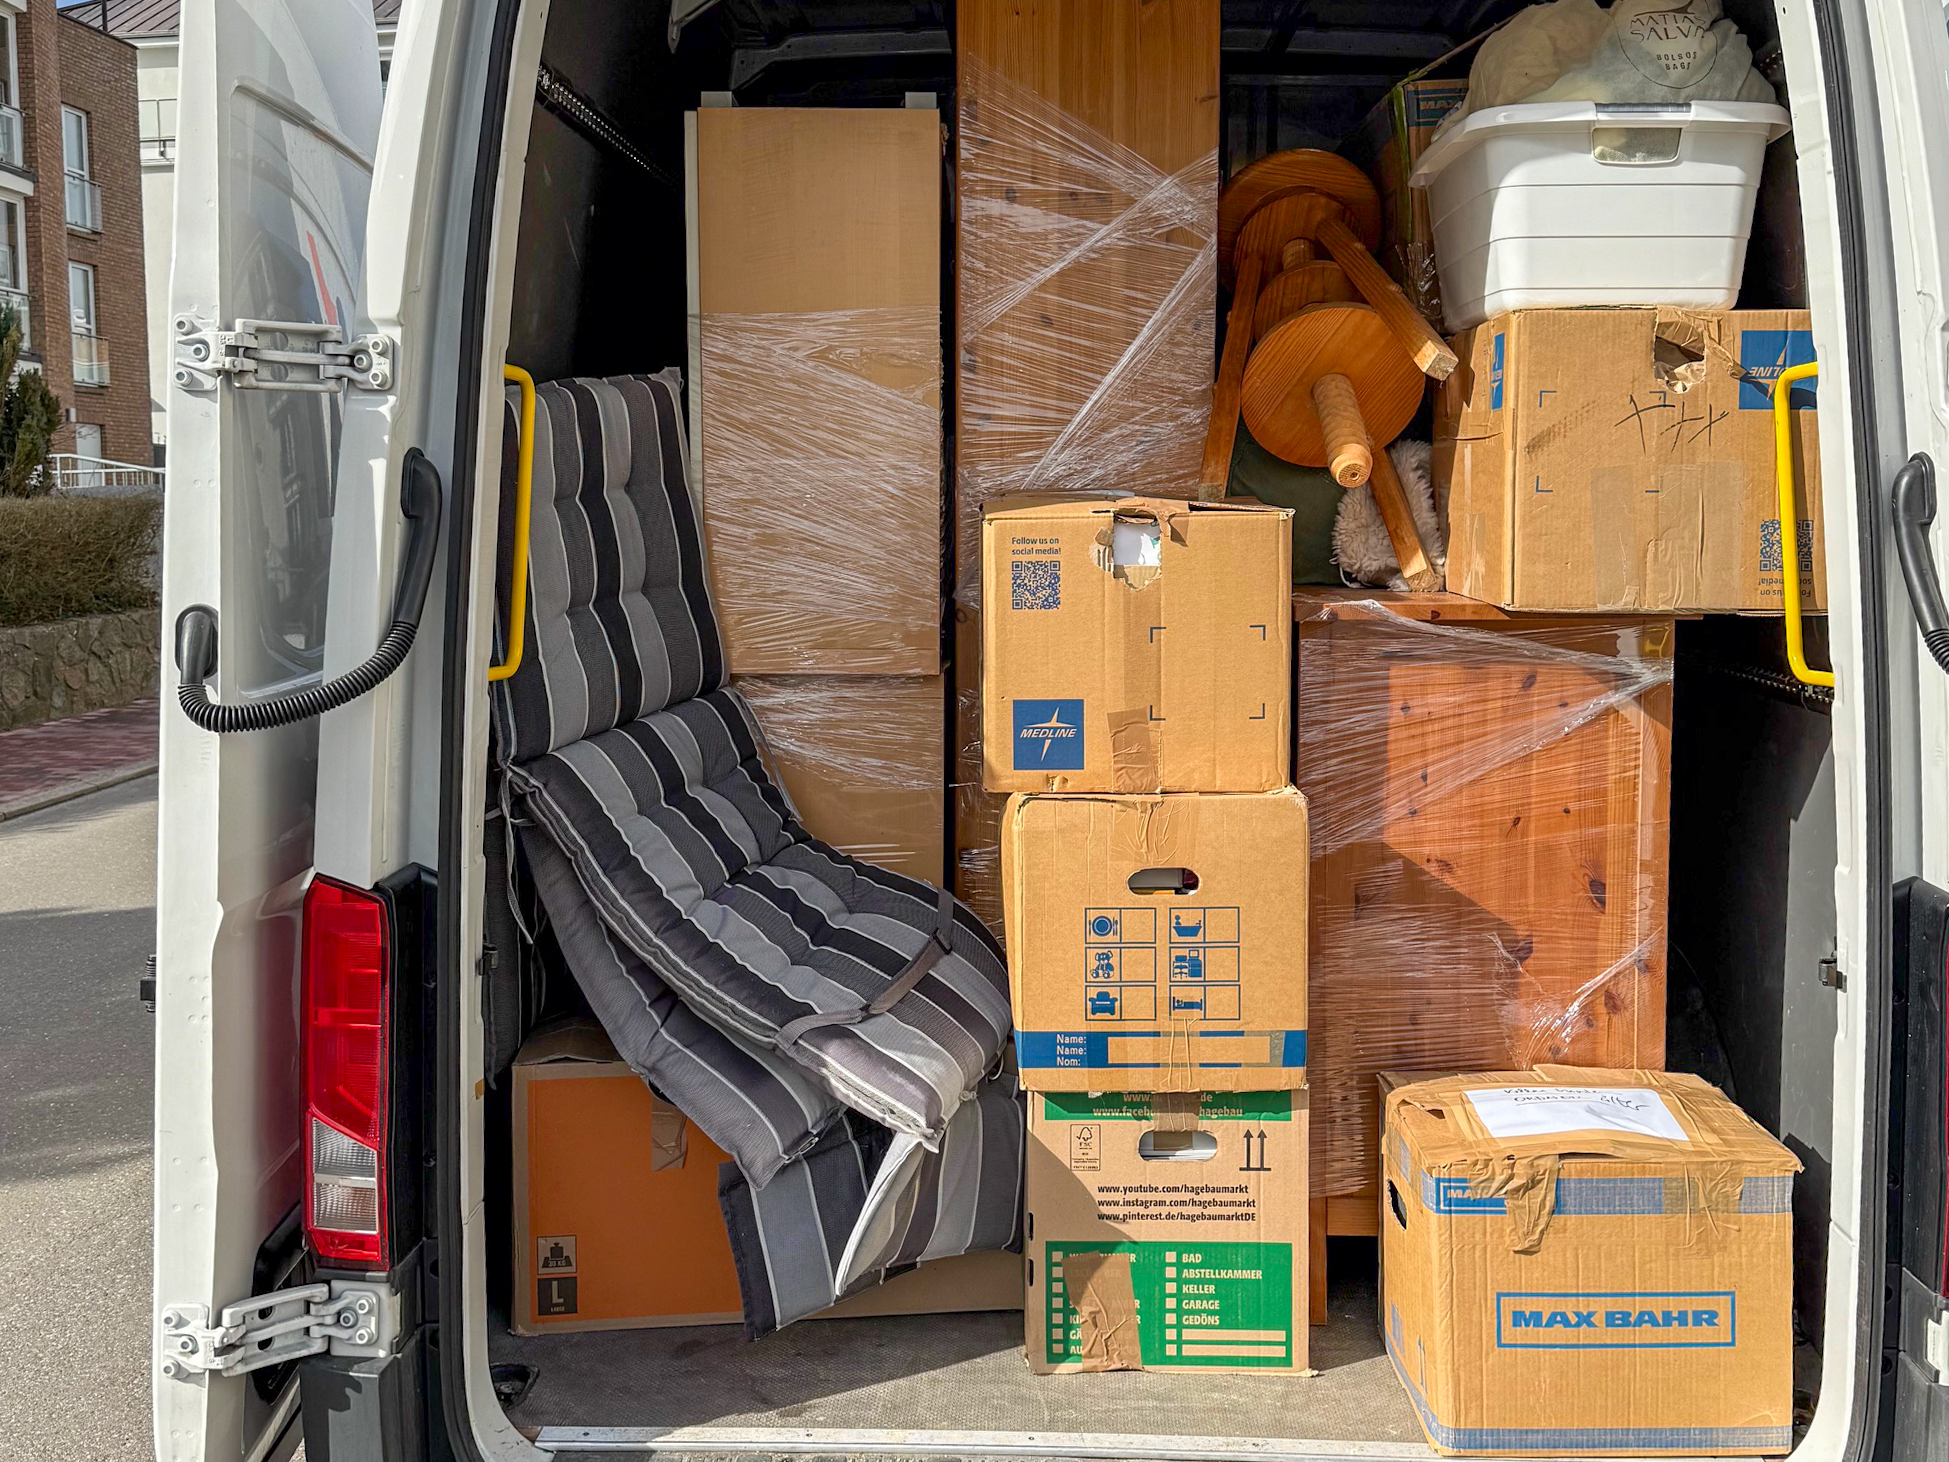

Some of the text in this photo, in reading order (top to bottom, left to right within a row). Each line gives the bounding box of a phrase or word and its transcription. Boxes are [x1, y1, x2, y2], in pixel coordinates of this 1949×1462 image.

[1656, 51, 1698, 61] BOLSOS
[1665, 62, 1691, 70] BAGS
[1011, 537, 1038, 545] Follow
[1011, 547, 1061, 556] social media!
[1772, 589, 1783, 597] us
[1020, 728, 1078, 738] MEDLINE
[1056, 1034, 1087, 1044] Name:
[1056, 1045, 1087, 1055] Name:
[1056, 1056, 1081, 1066] Nom:
[1097, 1184, 1249, 1196] www.youtube.com/hagebaumarkt
[1097, 1198, 1256, 1209] www.instagram.com/hagebaumarkt
[1097, 1212, 1256, 1223] www.pinterest.de/hagebaumarktDE
[1182, 1253, 1202, 1263] BAD
[1182, 1269, 1262, 1279] ABSTELLKAMMER
[552, 1280, 564, 1304] L
[1182, 1284, 1216, 1294] KELLER
[1182, 1300, 1220, 1310] GARAGE
[1182, 1313, 1220, 1325] GEDÖNS
[1511, 1309, 1719, 1328] MAX BAHR
